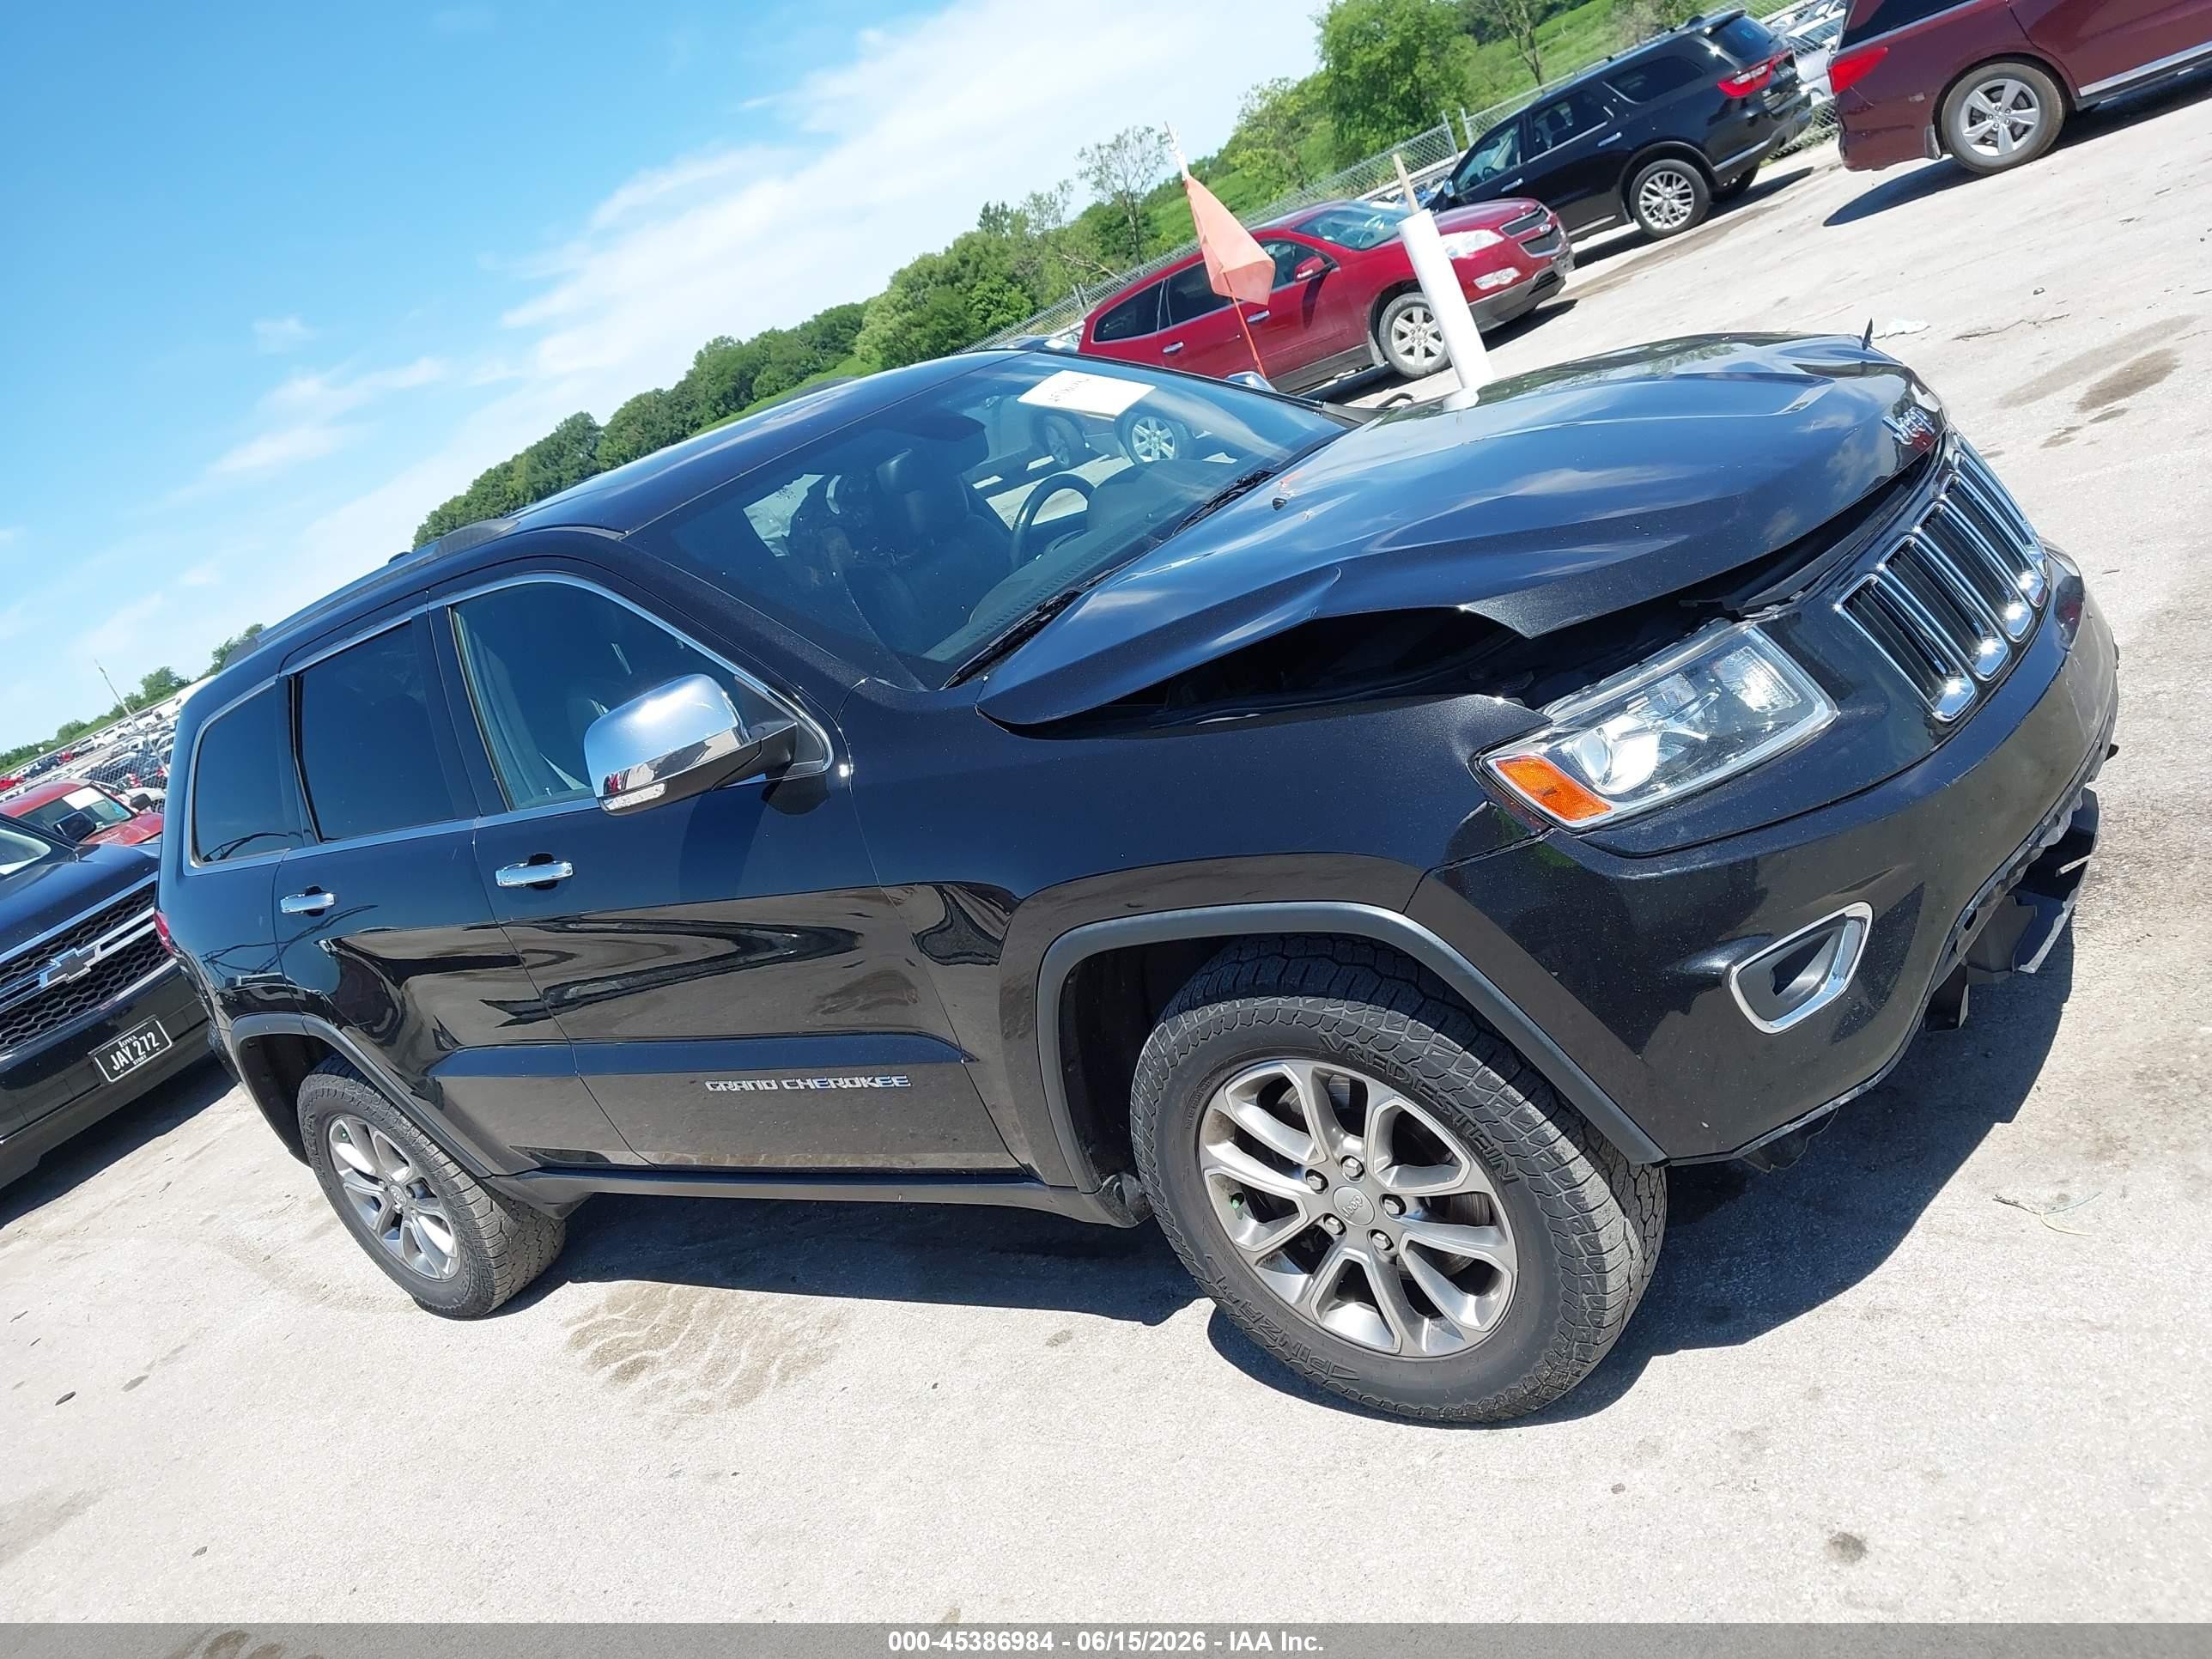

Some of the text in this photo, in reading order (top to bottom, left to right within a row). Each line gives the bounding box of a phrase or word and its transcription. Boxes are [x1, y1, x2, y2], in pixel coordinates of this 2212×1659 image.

[1881, 405, 1936, 446] Jeep
[110, 1031, 161, 1071] JAY 272
[132, 1054, 147, 1066] STORY
[703, 1074, 914, 1092] GRAND CHEROKEE
[1341, 1194, 1364, 1218] Jeep
